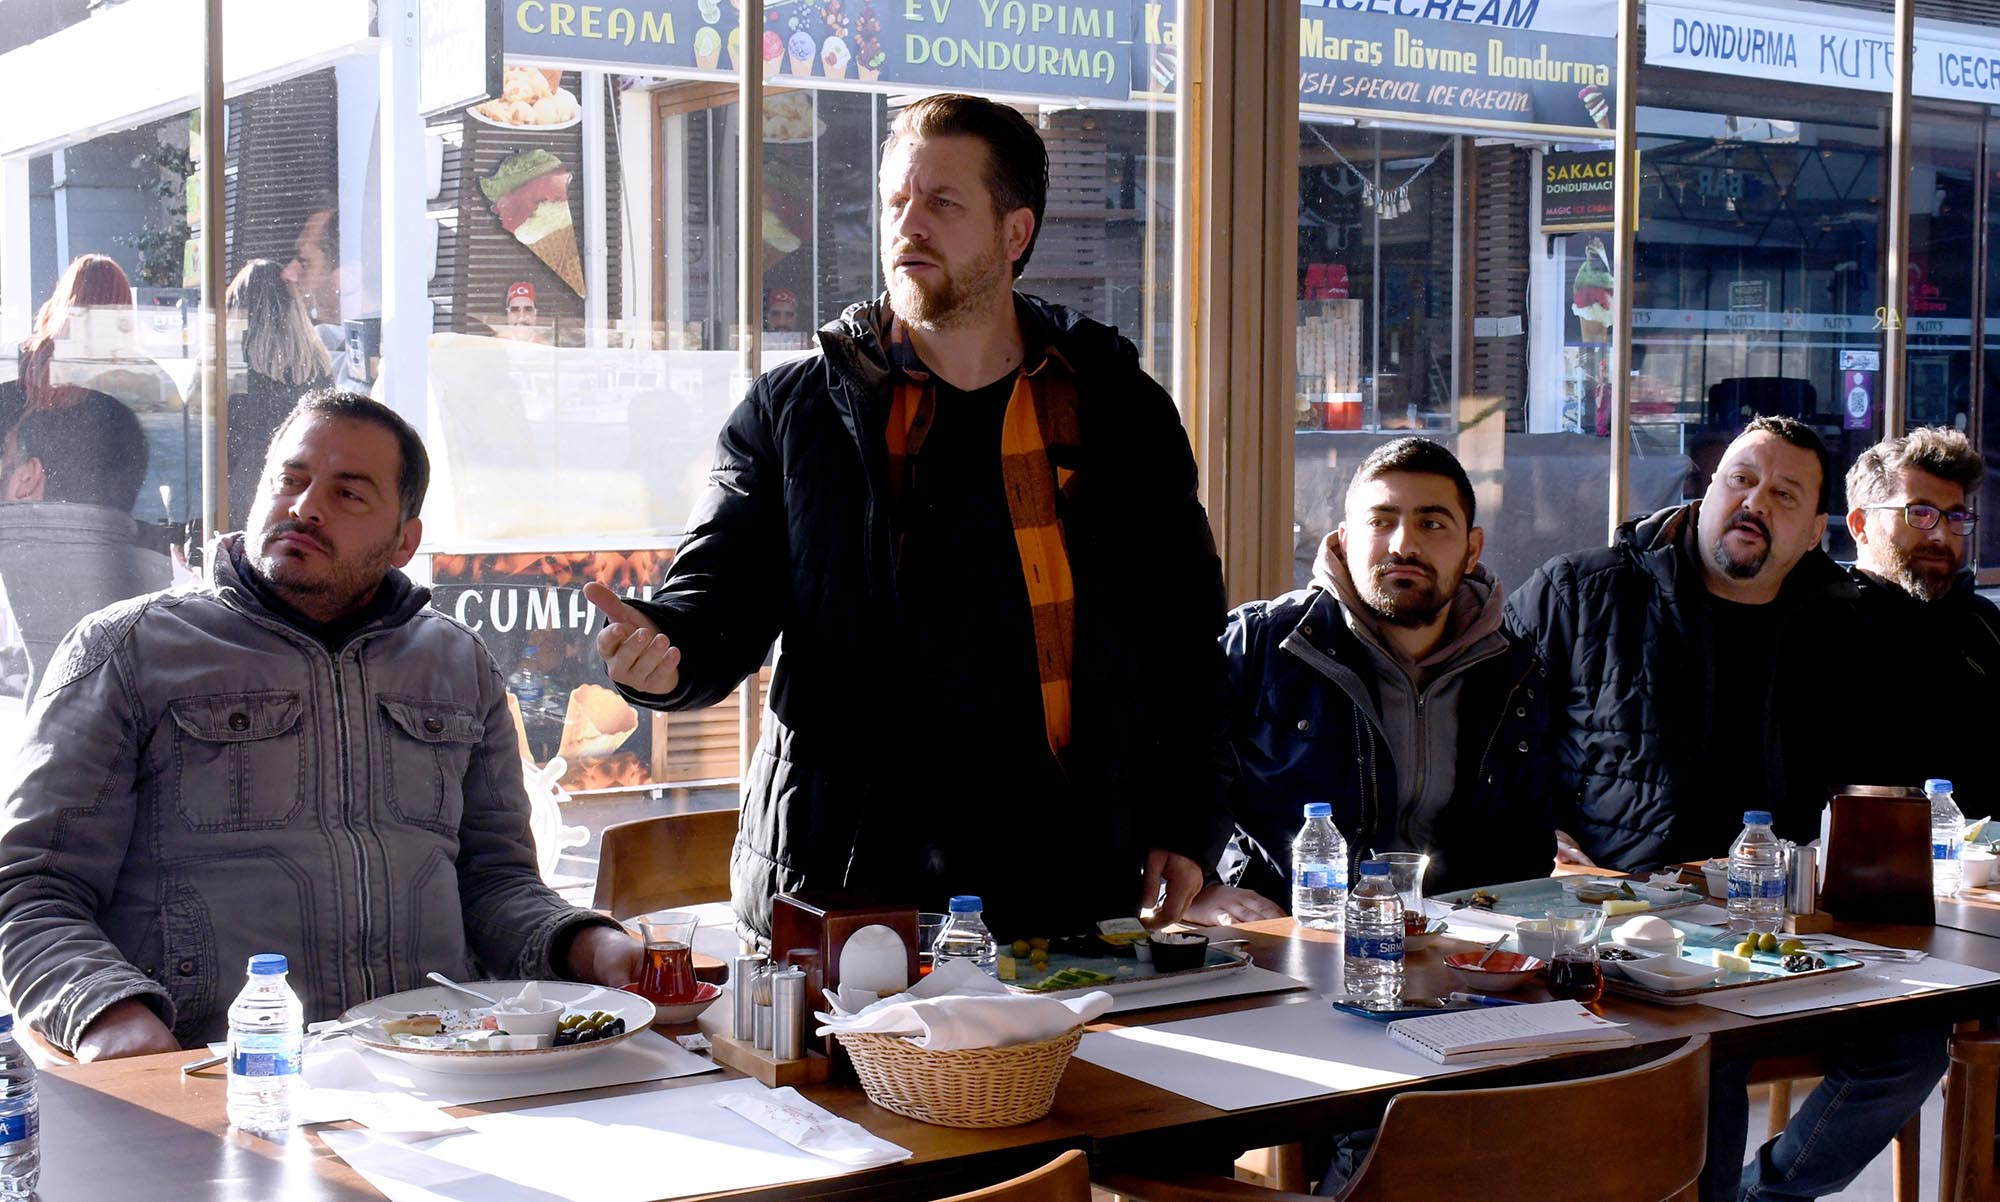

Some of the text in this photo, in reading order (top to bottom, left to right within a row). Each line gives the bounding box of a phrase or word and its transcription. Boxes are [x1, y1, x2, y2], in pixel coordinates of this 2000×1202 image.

[516, 0, 675, 46] CREAM
[905, 0, 1115, 38] EV YAPIMI
[1322, 0, 1540, 29] CREAM
[905, 33, 1116, 84] DONDURMA
[1299, 18, 1609, 87] Maraş Dövme Dondurma
[1672, 18, 1797, 69] DONDURMA
[1820, 34, 1917, 80] KUTE
[1426, 85, 1459, 107] ICE
[1545, 206, 1571, 216] MAGIC
[455, 586, 596, 636] CUMA
